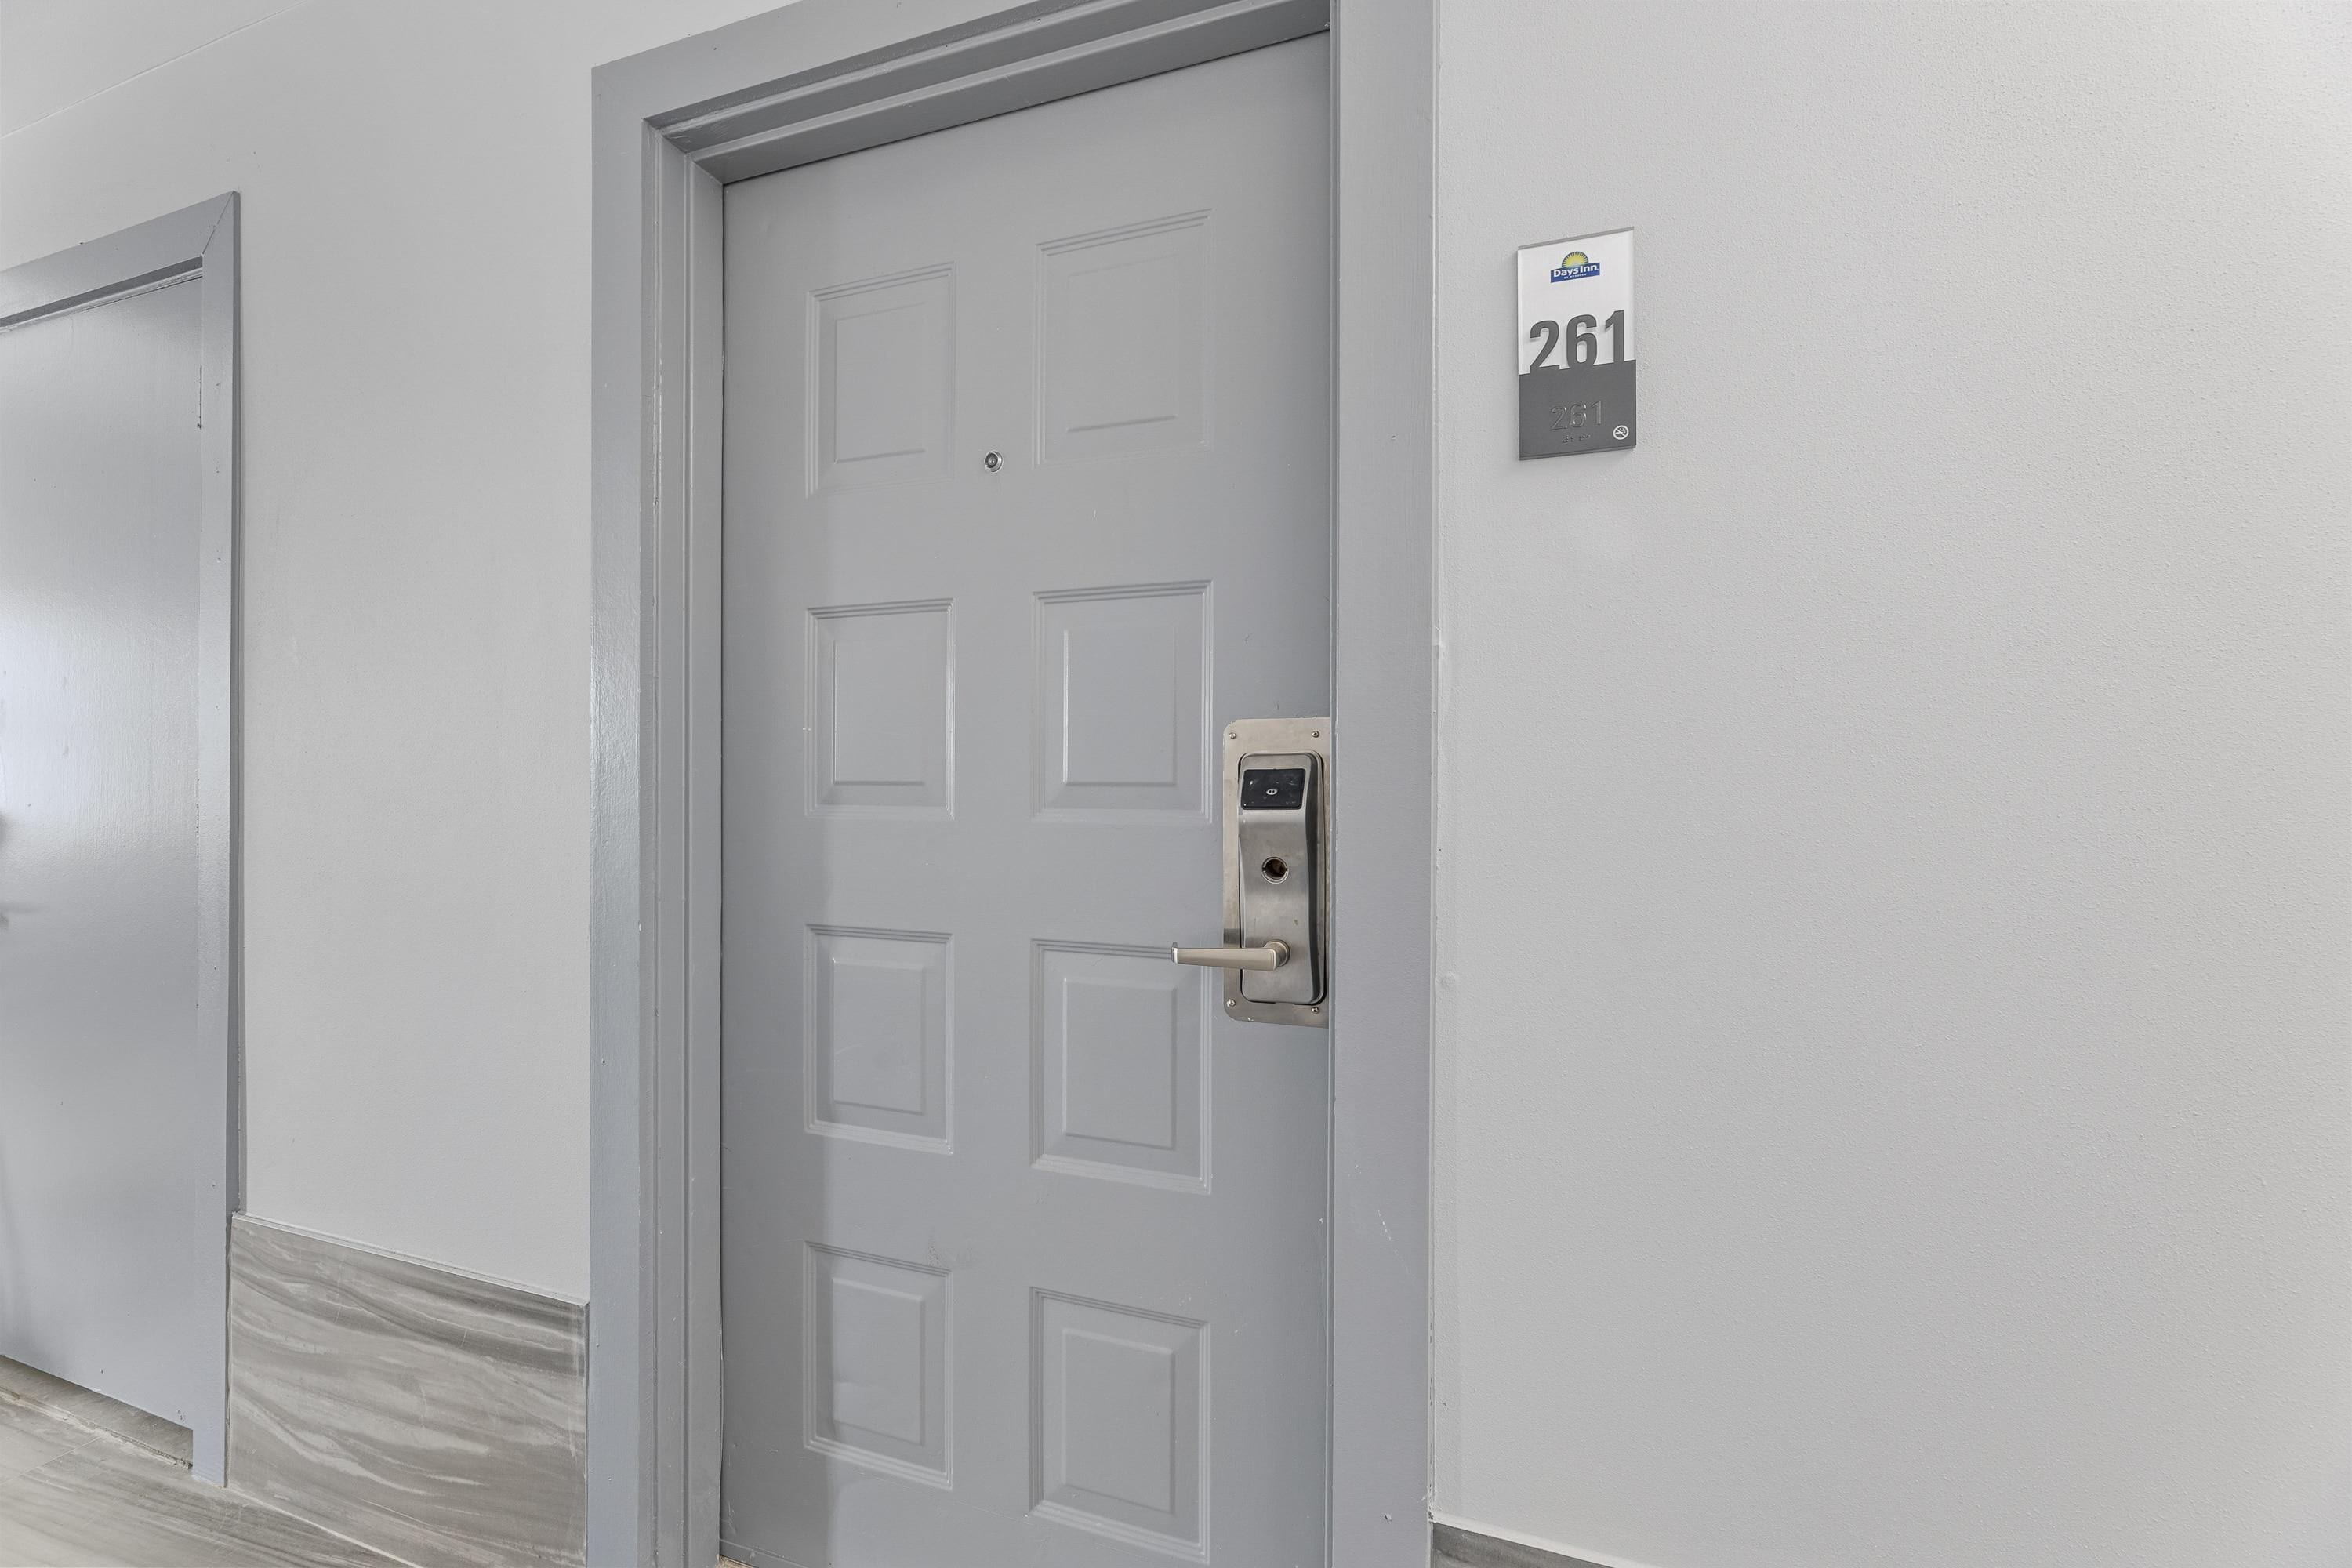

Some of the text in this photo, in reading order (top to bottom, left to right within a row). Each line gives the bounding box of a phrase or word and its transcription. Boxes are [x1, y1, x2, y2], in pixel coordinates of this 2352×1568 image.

[1553, 267, 1579, 278] Days
[1580, 264, 1597, 273] Inn
[1530, 310, 1625, 374] 261
[1550, 401, 1602, 430] 261
